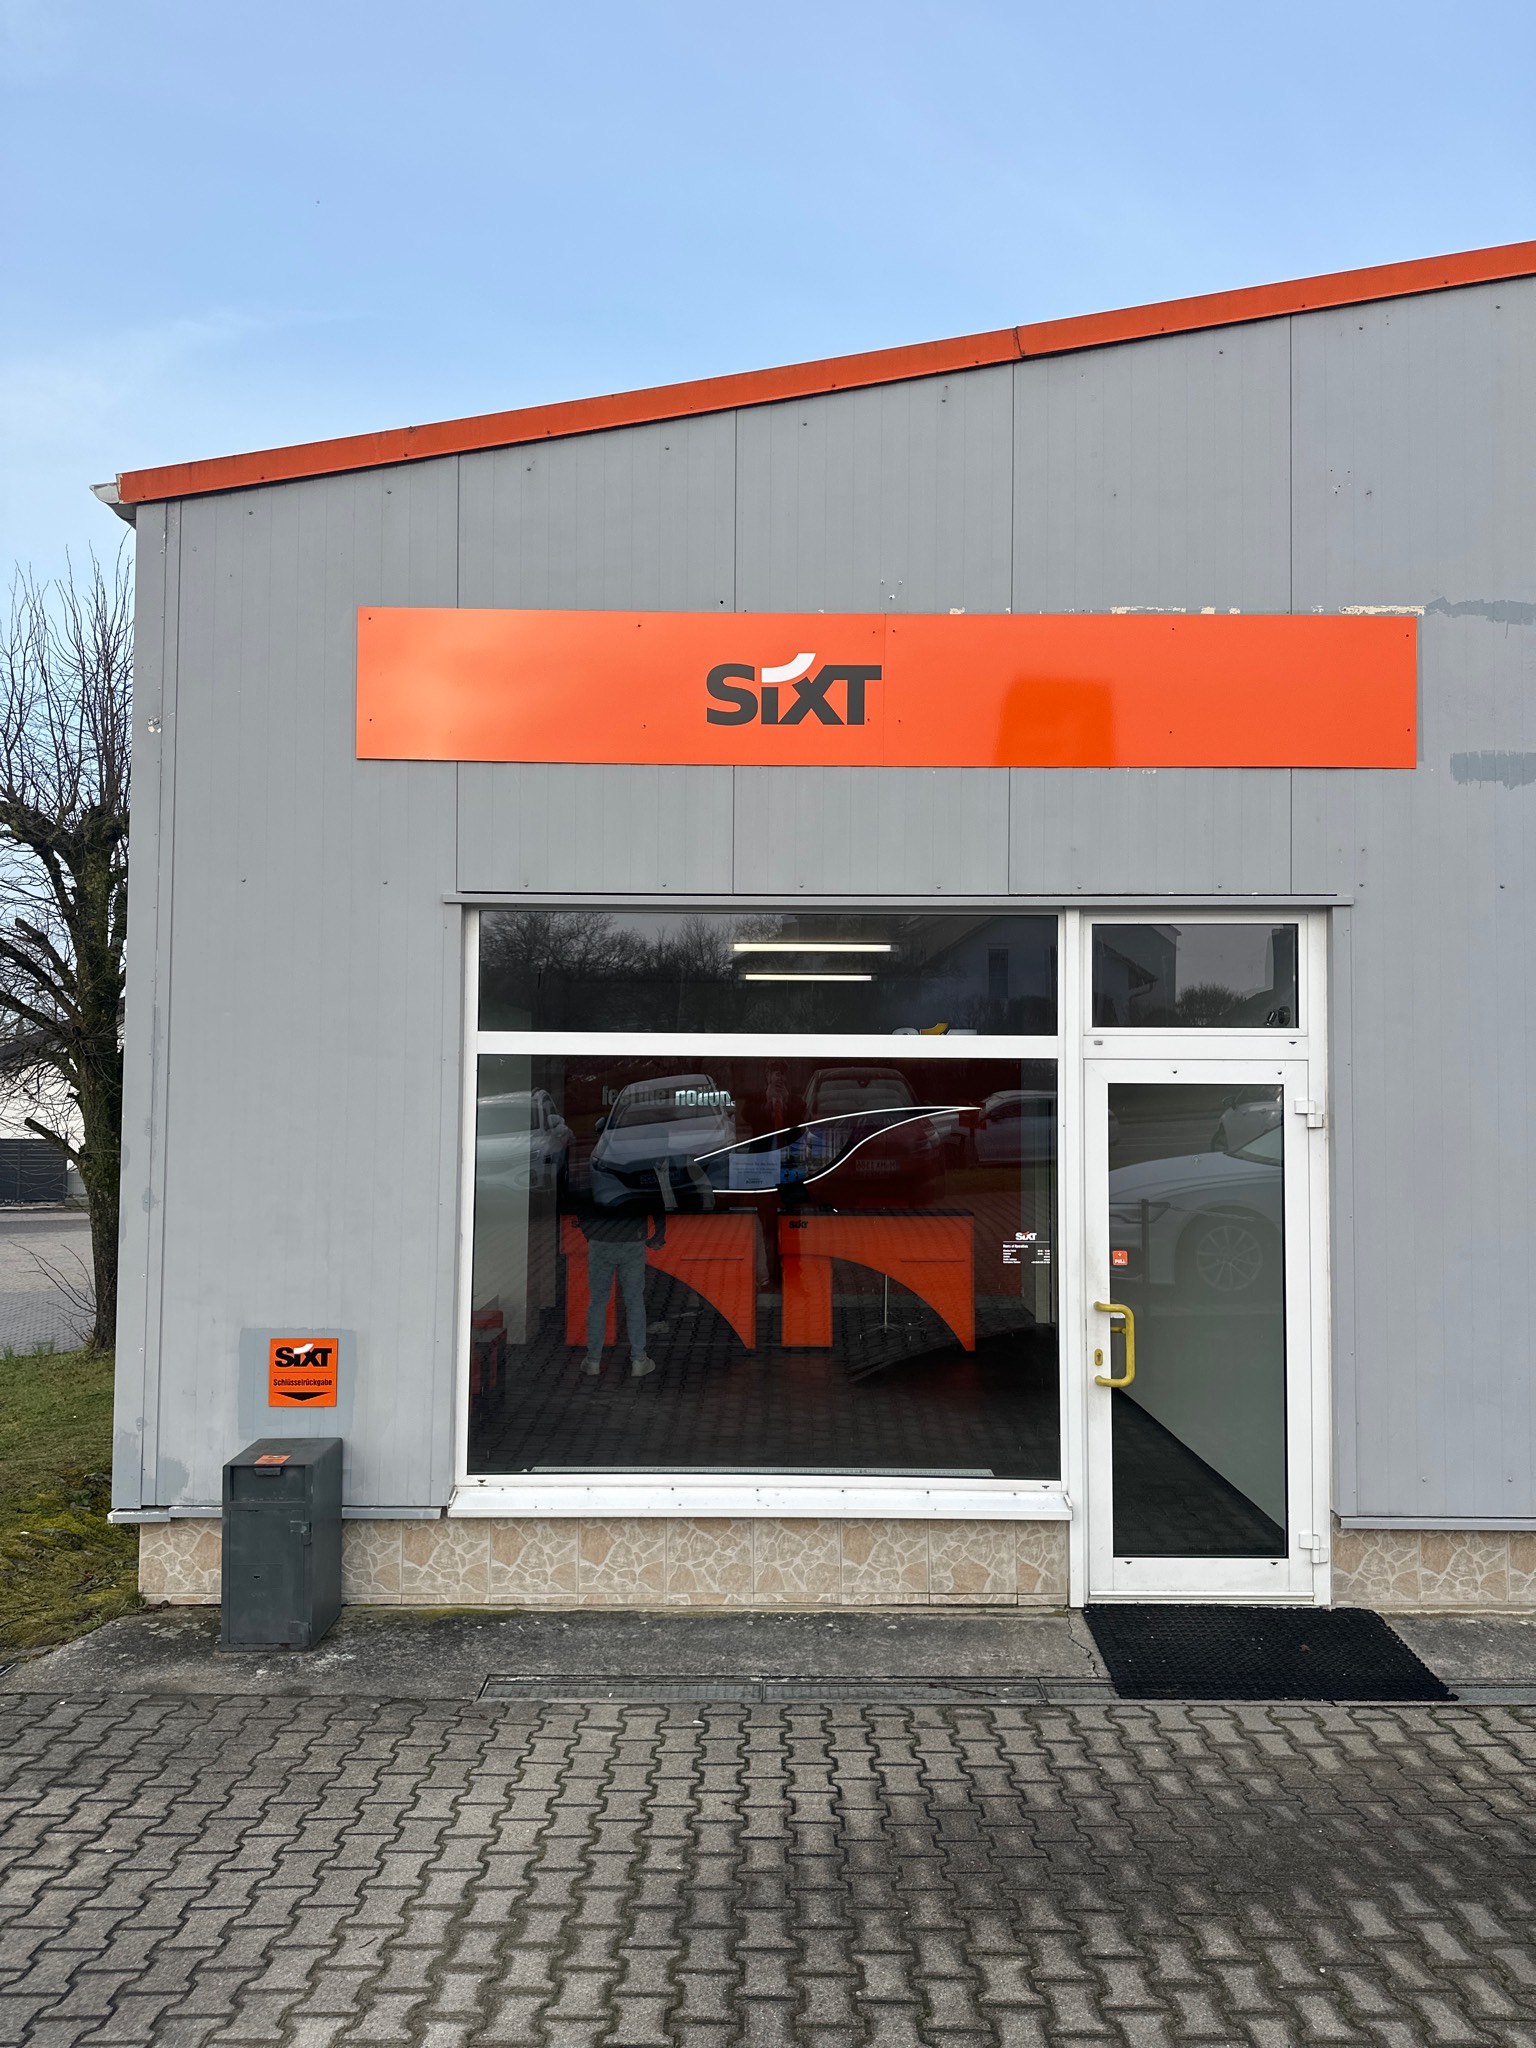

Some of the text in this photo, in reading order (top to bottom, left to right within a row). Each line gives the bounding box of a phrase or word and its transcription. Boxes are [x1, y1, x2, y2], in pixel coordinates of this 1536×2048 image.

[706, 652, 882, 726] SIXT
[1015, 1231, 1037, 1241] SIXT
[274, 1343, 333, 1368] SIXT
[272, 1378, 333, 1387] Schlüsselrückgabe
